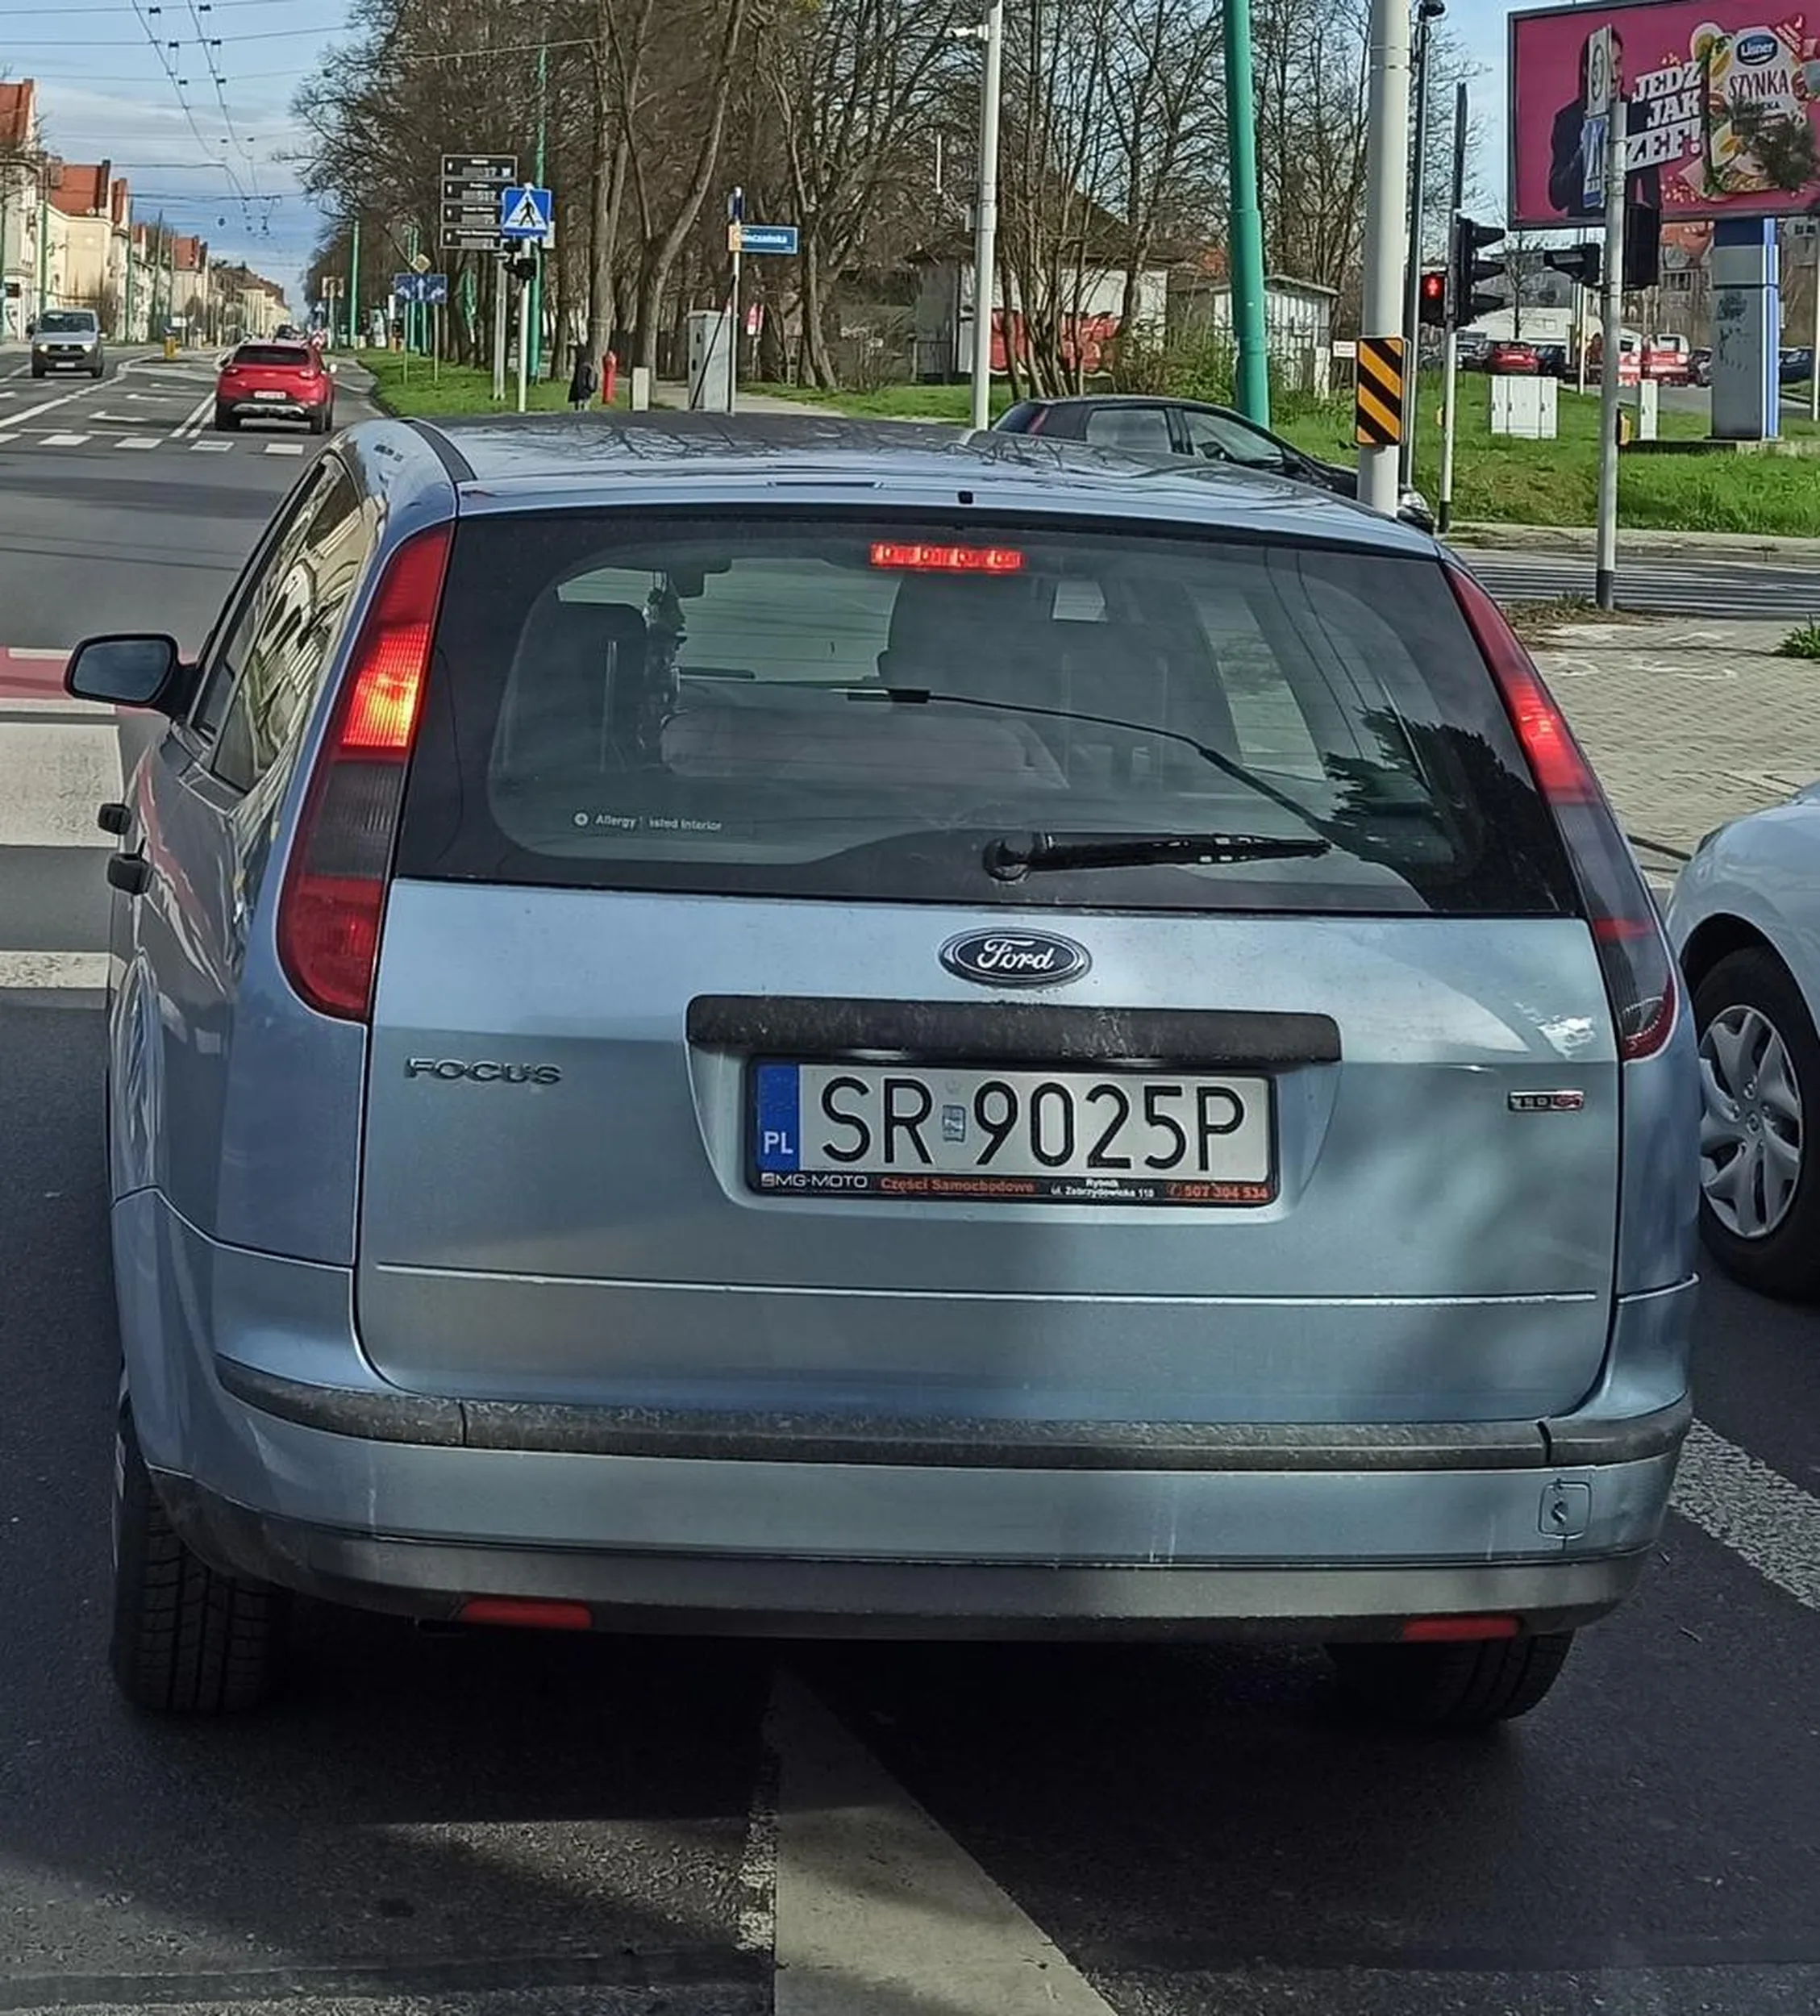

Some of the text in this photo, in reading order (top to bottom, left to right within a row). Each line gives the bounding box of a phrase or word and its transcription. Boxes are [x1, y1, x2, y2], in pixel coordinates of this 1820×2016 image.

[1631, 60, 1701, 103] JEDZ
[1728, 69, 1789, 98] SZYNKA
[1647, 88, 1701, 129] JAK
[1626, 118, 1701, 171] ZEF!
[977, 938, 1055, 970] Ford
[405, 1057, 562, 1085] FOCUS
[822, 1076, 1246, 1172] SR 9025P
[764, 1131, 793, 1154] PL
